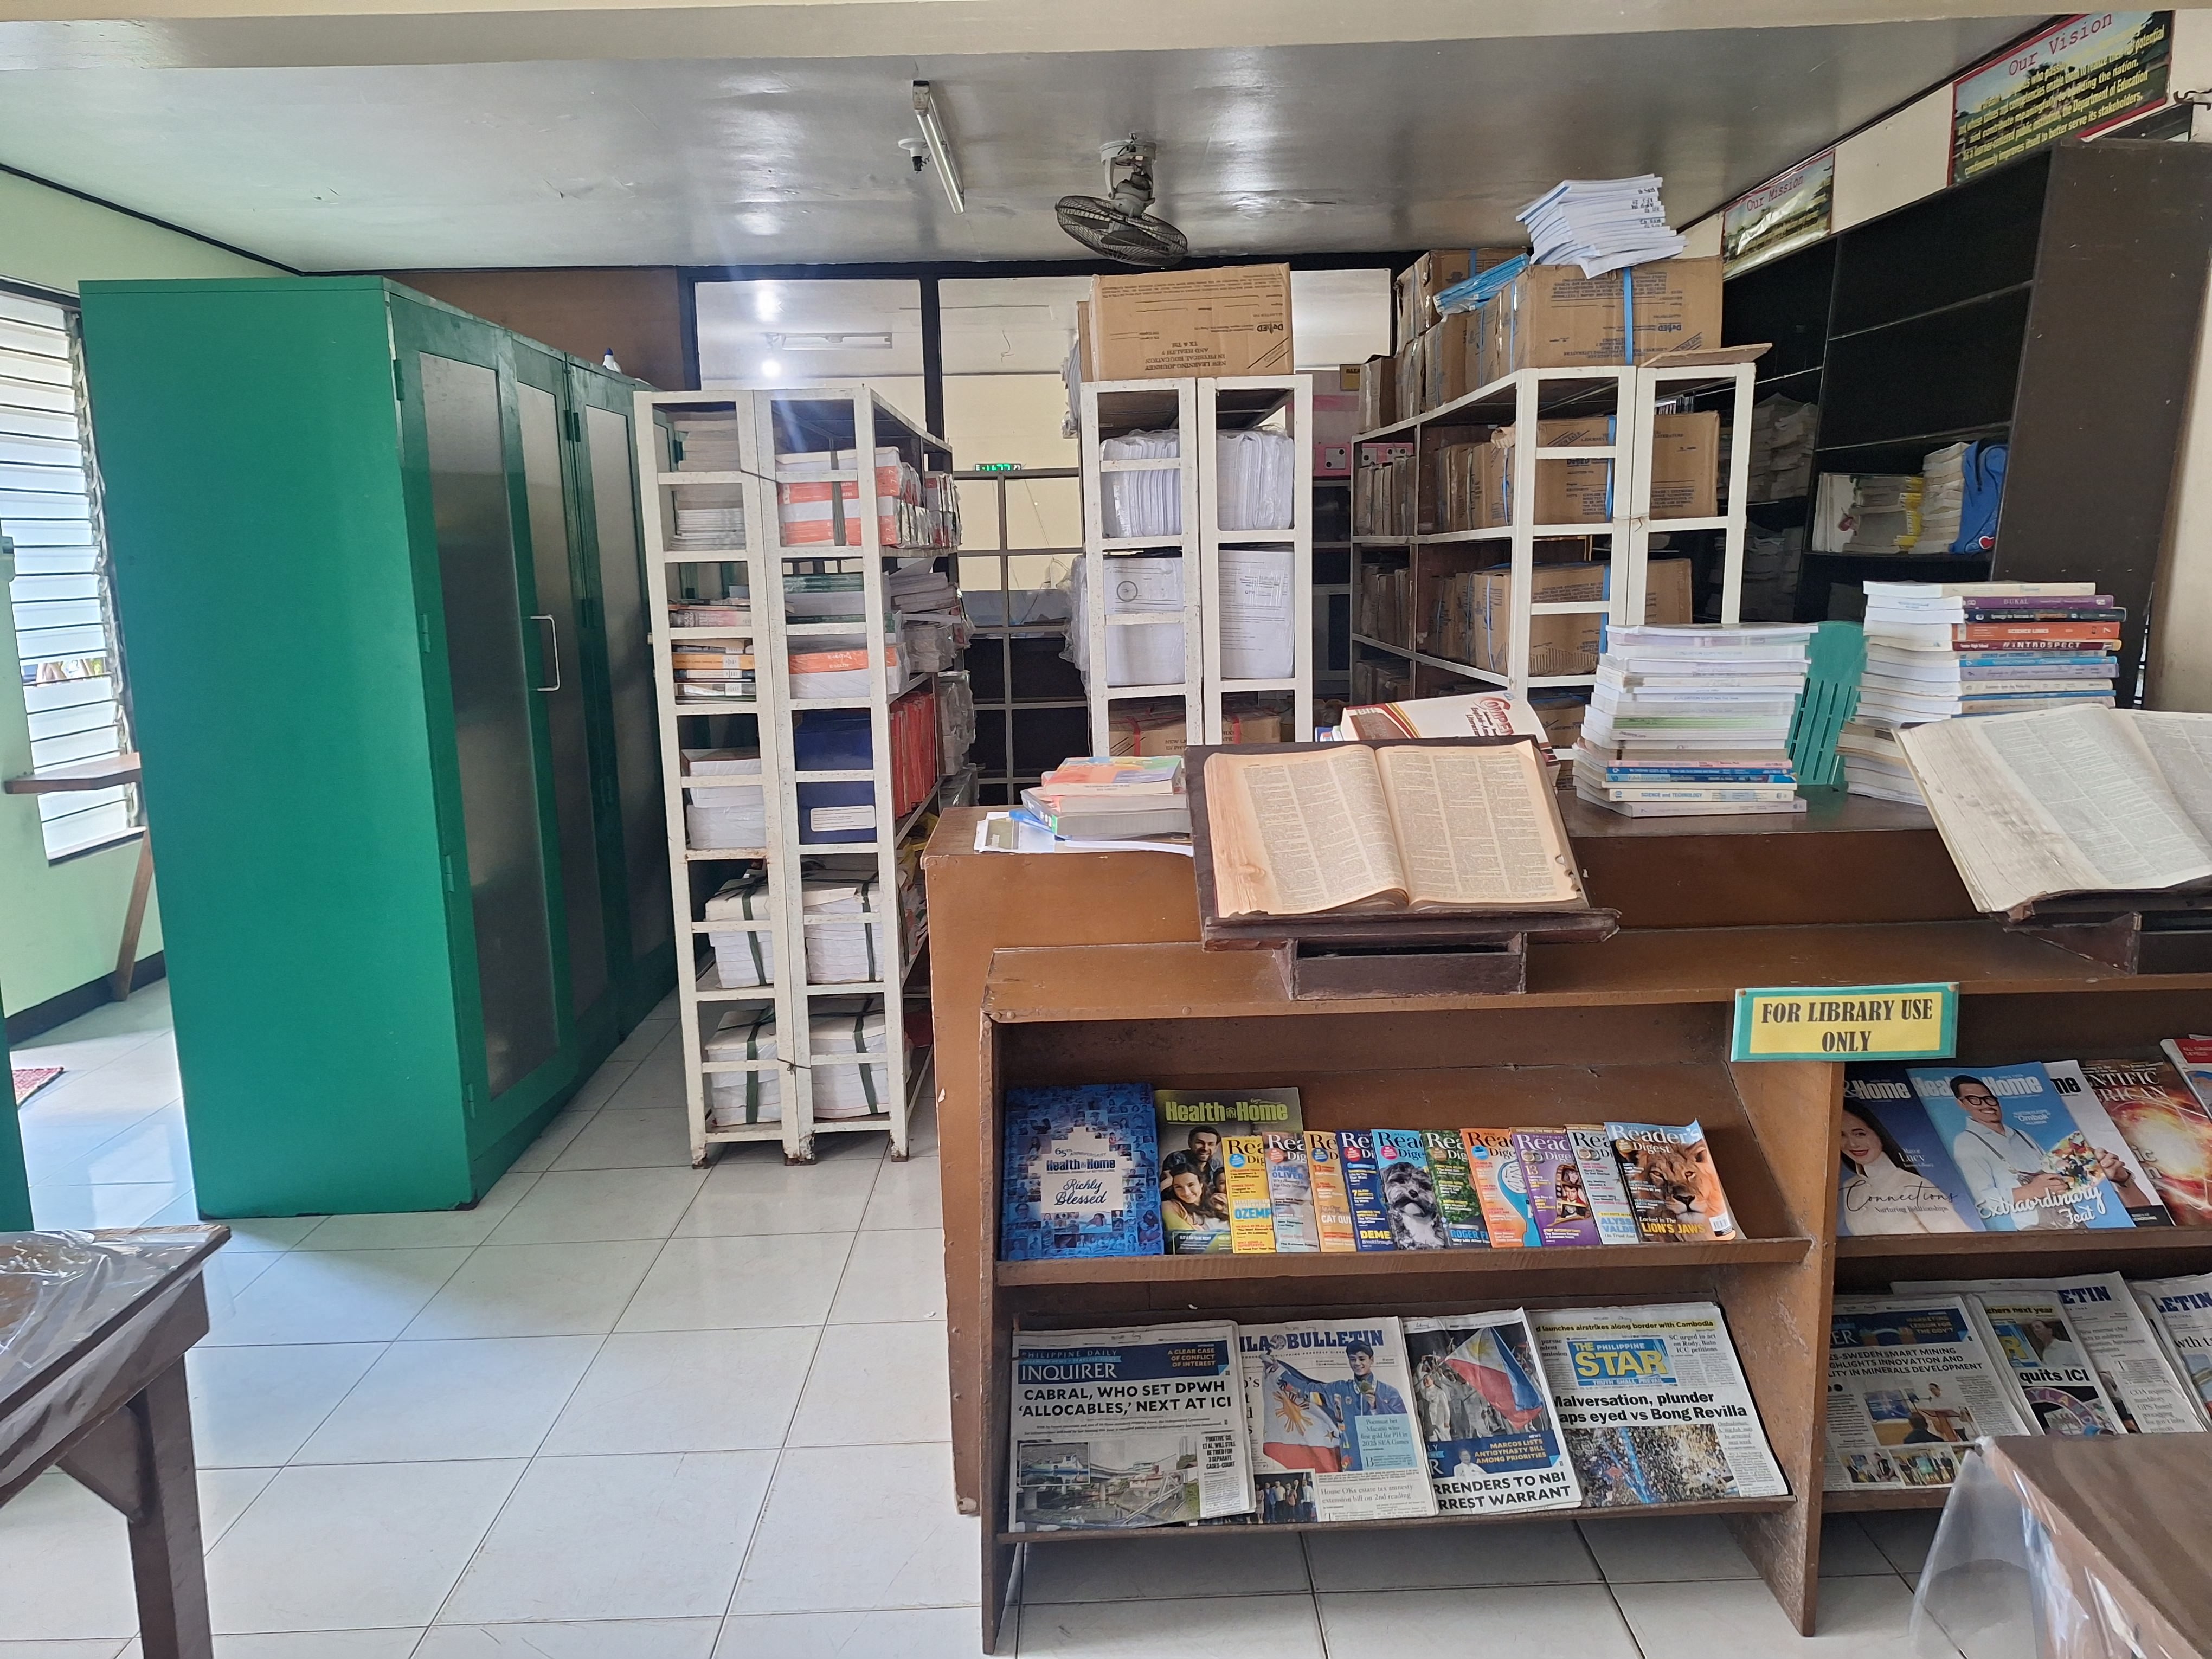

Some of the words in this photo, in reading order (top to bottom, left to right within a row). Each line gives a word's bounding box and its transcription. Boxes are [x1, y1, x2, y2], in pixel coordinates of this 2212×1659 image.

[2009, 52, 2037, 75] Our
[2049, 14, 2112, 54] Vision
[2099, 68, 2111, 83] the
[2112, 55, 2139, 77] nation.
[2073, 86, 2108, 114] Department
[2109, 83, 2117, 96] of
[2117, 67, 2148, 93] Education
[2068, 115, 2087, 131] serve
[2088, 109, 2097, 122] its
[2098, 88, 2143, 118] stakeholders.
[1746, 197, 1764, 211] Our
[1768, 175, 1804, 202] Mission
[1761, 1002, 1802, 1023] FOR
[1807, 1000, 1895, 1021] LIBRARY
[1901, 999, 1933, 1020] USE
[1822, 1031, 1872, 1052] ONLY
[1852, 1079, 1912, 1099] Home
[1982, 1075, 2044, 1097] Home
[1166, 1101, 1226, 1122] Health
[1236, 1101, 1288, 1122] Home
[1609, 1124, 1702, 1146] Reader's
[1633, 1142, 1671, 1154] Digest
[1046, 1159, 1081, 1171] Health
[1086, 1159, 1116, 1169] Home
[1898, 1152, 1925, 1163] Lucy
[1525, 1166, 1539, 1175] 13
[1063, 1179, 1103, 1194] Richly
[1054, 1191, 1107, 1206] Blessed
[1838, 1179, 1958, 1212] Connections
[1976, 1186, 2106, 1220] Extraordinary
[1908, 1205, 1949, 1214] Relationships
[2059, 1205, 2096, 1225] Feat
[1321, 1214, 1336, 1223] CAT
[1450, 1230, 1480, 1239] ROGER
[1642, 1223, 1675, 1234] LION'S
[1677, 1223, 1706, 1234] JAWS
[2033, 1307, 2054, 1315] year
[1611, 1323, 1631, 1332] along
[1632, 1322, 1658, 1330] border
[1676, 1320, 1714, 1328] Cambodia
[1286, 1330, 1384, 1349] BULLETIN
[1679, 1333, 1698, 1341] urged
[1086, 1349, 1118, 1357] DAILY
[1573, 1342, 1596, 1352] THE
[1597, 1342, 1645, 1351] PHILIPPINE
[1691, 1346, 1718, 1354] petitions
[1886, 1349, 1918, 1358] SMART
[1919, 1347, 1957, 1356] MINING
[1574, 1350, 1668, 1378] STAR
[1861, 1365, 1911, 1375] MINERALS
[1912, 1362, 1984, 1373] DEVELOPMENT
[1877, 1356, 1941, 1366] INNOVATION
[1021, 1362, 1118, 1381] INQUIRER
[2019, 1369, 2063, 1384] quits
[2065, 1369, 2091, 1382] ICI
[1024, 1387, 1094, 1402] CABRAL,
[1097, 1386, 1139, 1399] WHO
[1142, 1383, 1171, 1396] SET
[1175, 1380, 1226, 1394] DPWH
[1657, 1391, 1714, 1406] plunder
[1136, 1398, 1181, 1412] NEXT
[1185, 1397, 1208, 1410] AT
[1211, 1396, 1232, 1408] ICI
[1590, 1409, 1628, 1425] eyed
[1630, 1410, 1649, 1421] vs
[1652, 1407, 1693, 1422] Bong
[1695, 1405, 1747, 1419] Revilla
[1490, 1439, 1522, 1449] MARCOS
[1474, 1446, 1528, 1458] ANTIDYNASTY
[1476, 1455, 1506, 1464] AMONG
[1506, 1452, 1547, 1462] PRIORITIES
[1388, 1483, 1413, 1491] amnesty
[1513, 1476, 1536, 1488] TO
[1539, 1471, 1567, 1483] NBI
[1322, 1495, 1352, 1504] extension
[1387, 1491, 1412, 1501] reading
[1438, 1496, 1486, 1511] RREST
[1488, 1486, 1571, 1506] WARRANT
